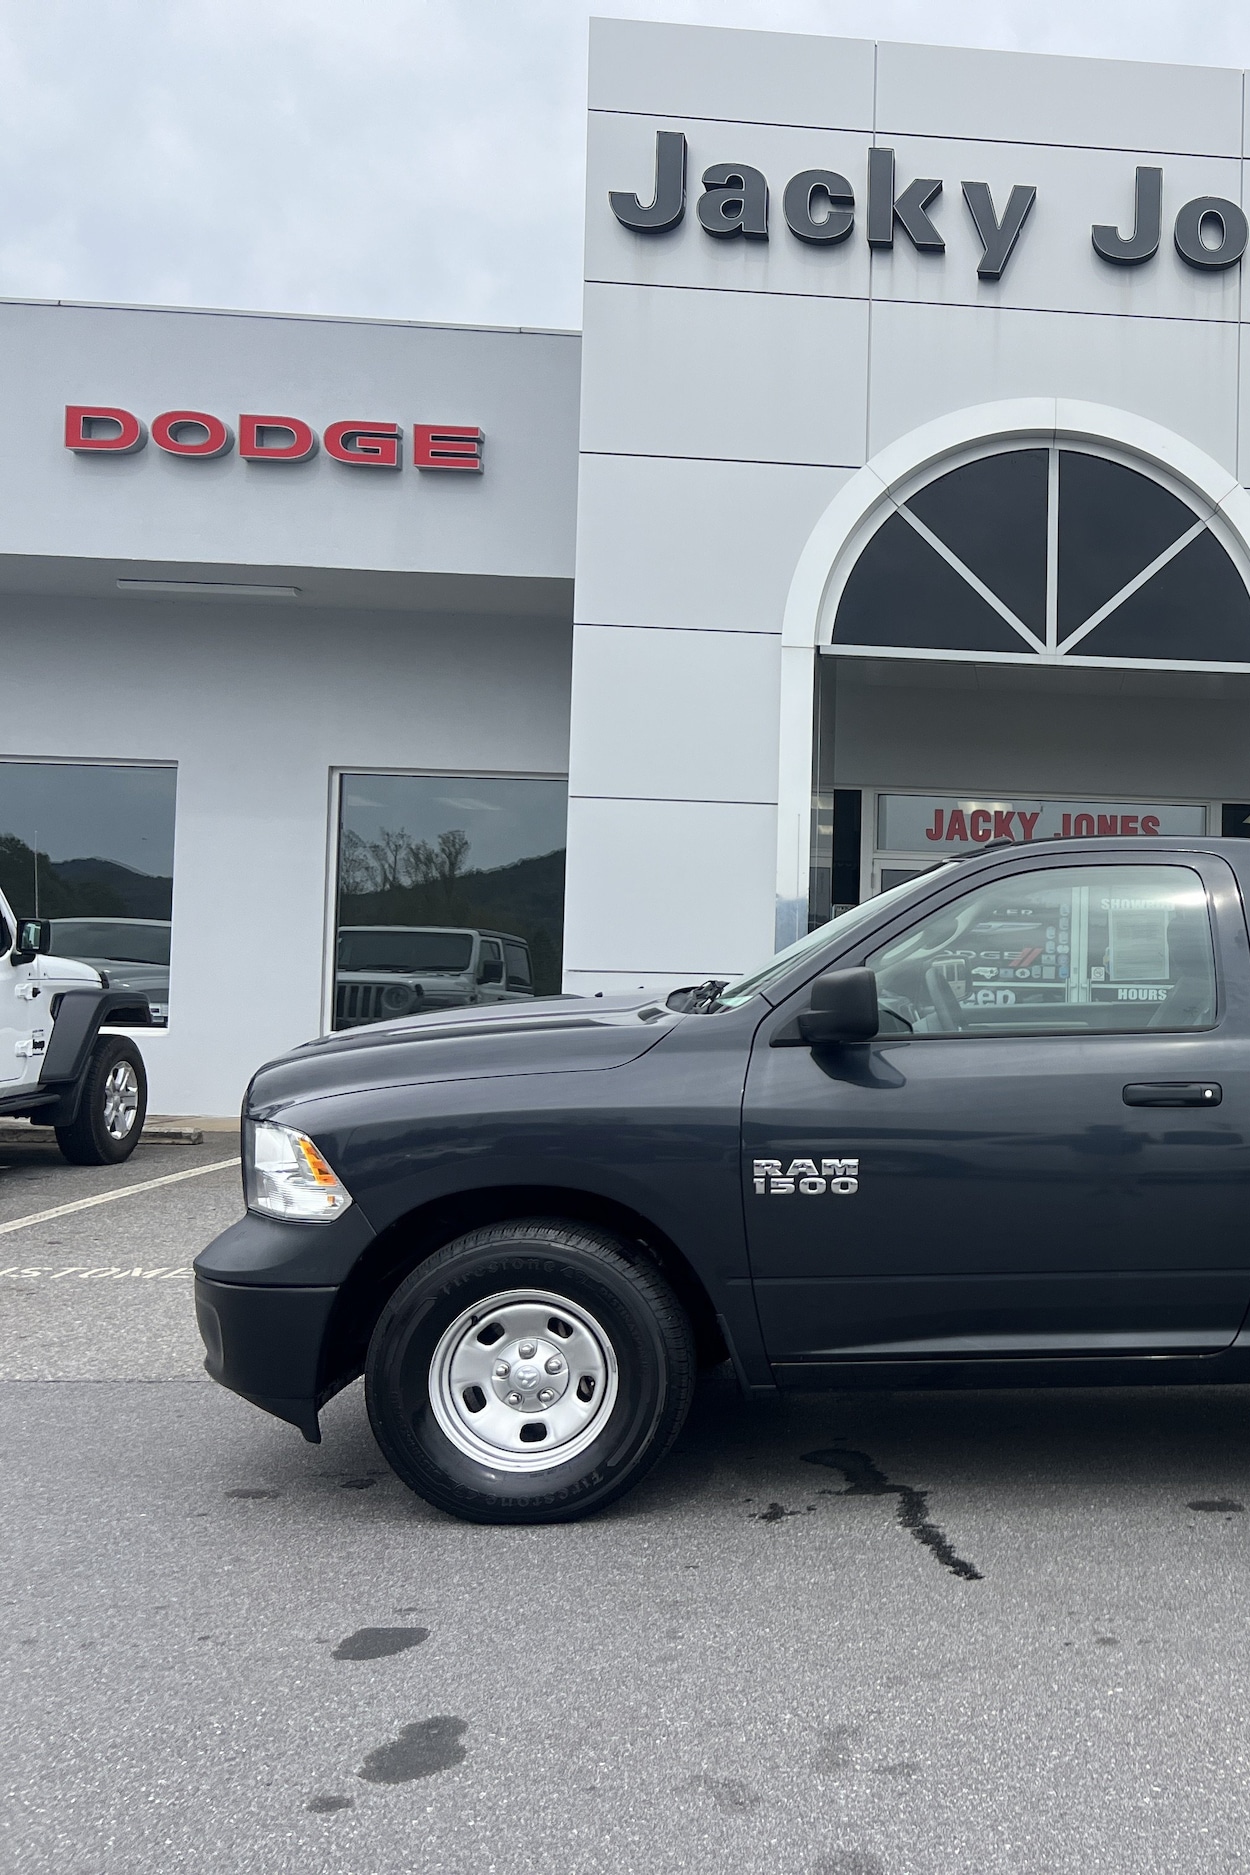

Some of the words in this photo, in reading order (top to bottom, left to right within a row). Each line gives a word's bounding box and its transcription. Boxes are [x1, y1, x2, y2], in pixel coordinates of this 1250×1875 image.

[608, 130, 1038, 281] Jacky
[63, 403, 485, 475] DODGE
[925, 808, 1041, 842] JACKY
[1117, 988, 1168, 1001] HOURS
[752, 1158, 860, 1177] RAM
[752, 1177, 859, 1195] 1500
